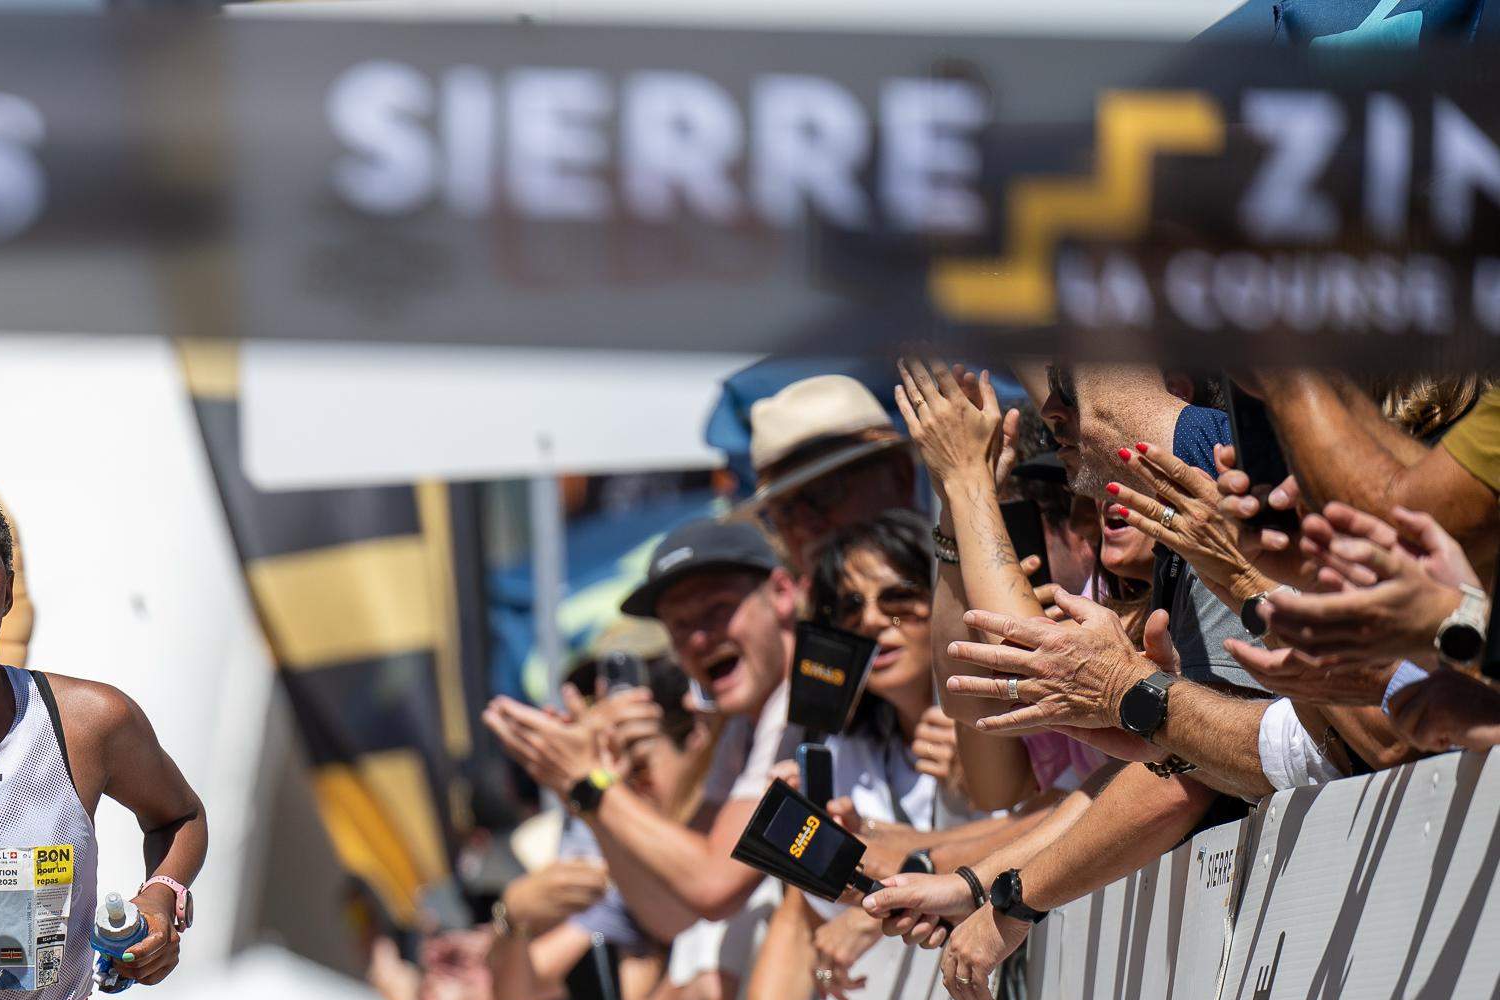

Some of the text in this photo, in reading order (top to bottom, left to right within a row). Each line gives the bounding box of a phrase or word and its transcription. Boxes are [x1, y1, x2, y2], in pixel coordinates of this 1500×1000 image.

[322, 60, 988, 234] SIERRE
[37, 848, 70, 862] BON
[37, 866, 56, 876] pour
[37, 877, 59, 886] repas
